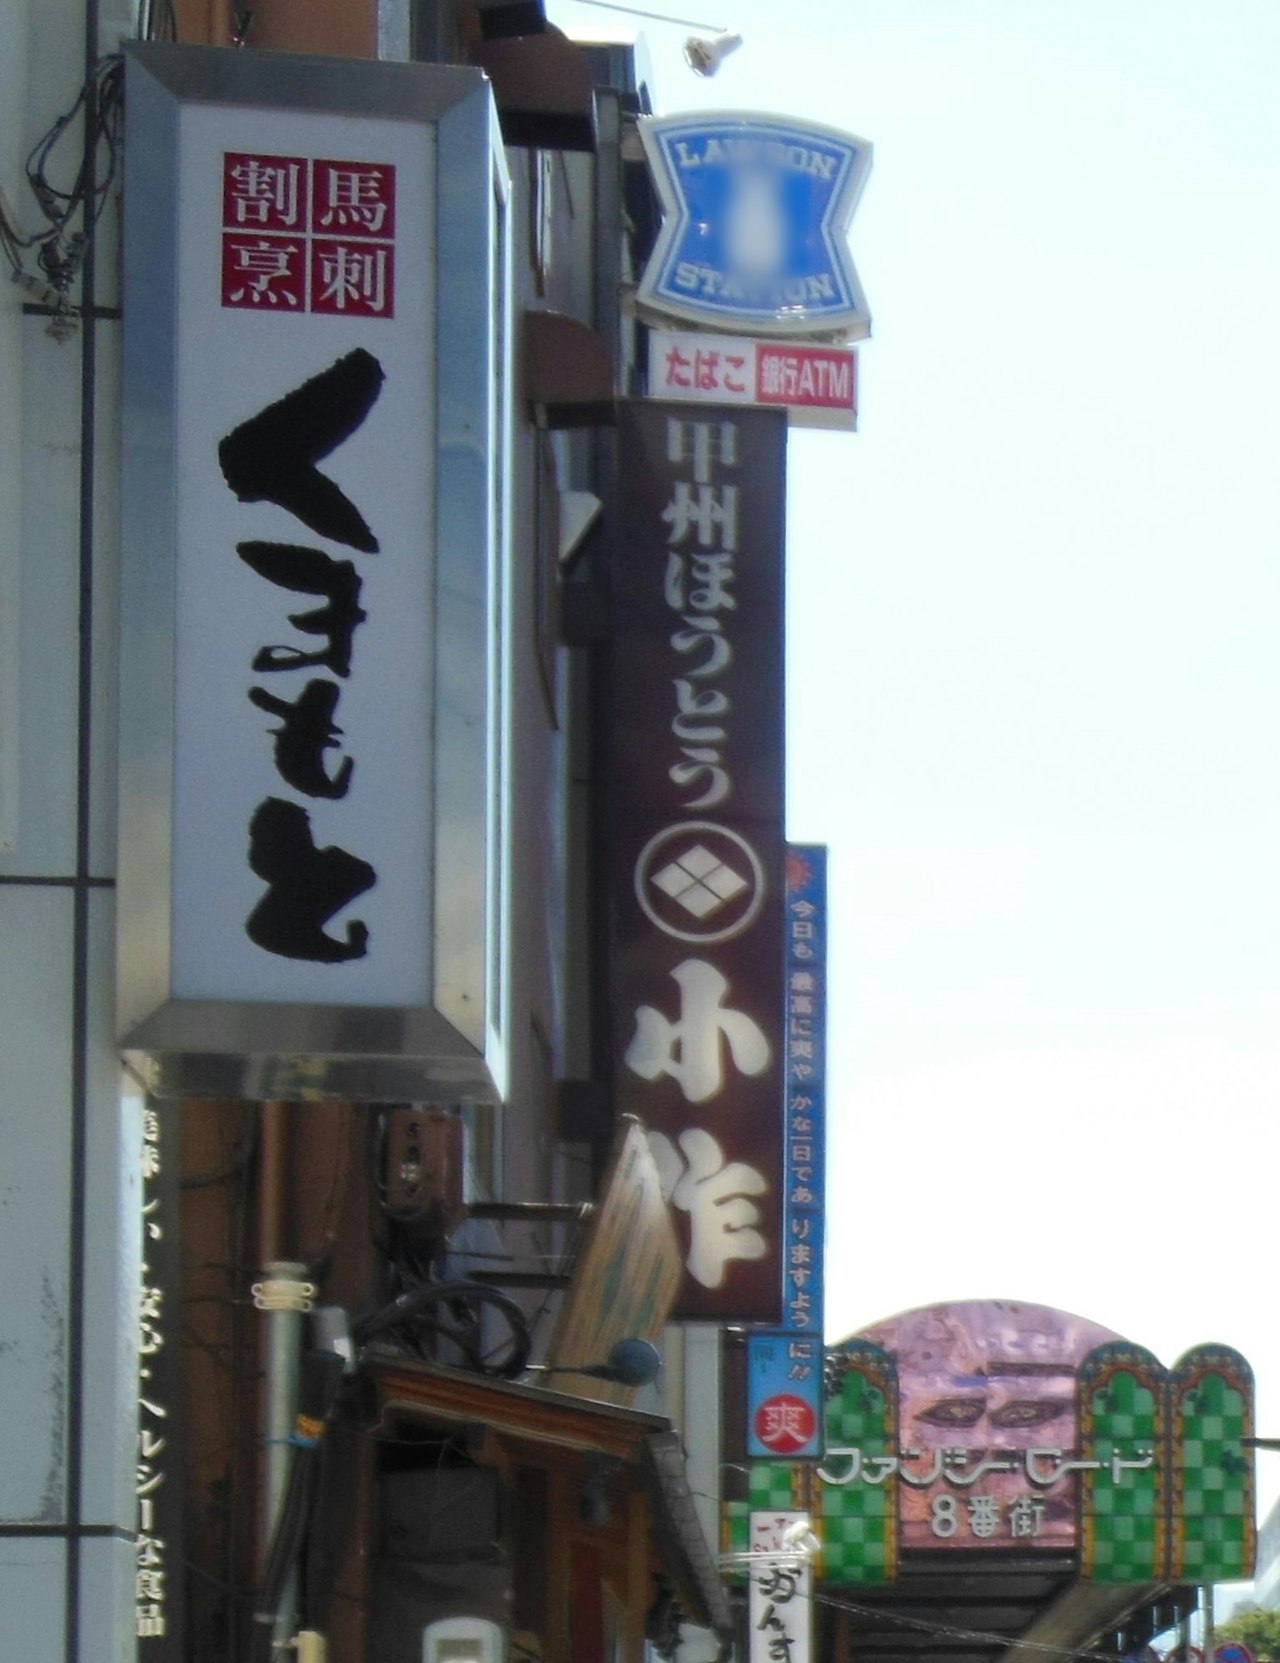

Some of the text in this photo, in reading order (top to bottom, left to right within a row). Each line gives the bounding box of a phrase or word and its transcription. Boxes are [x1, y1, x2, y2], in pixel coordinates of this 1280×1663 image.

[674, 140, 838, 181] LAON
[674, 261, 836, 301] STAON
[665, 347, 745, 393] たばこ
[760, 352, 849, 399] 銀行ATM
[661, 416, 739, 809] 甲州ほうとう
[218, 348, 386, 964] くまもと
[625, 958, 773, 1289] 小作
[762, 1402, 806, 1442] 爽
[817, 1447, 1153, 1485] ファンシーロード
[931, 1494, 1046, 1538] 8番街
